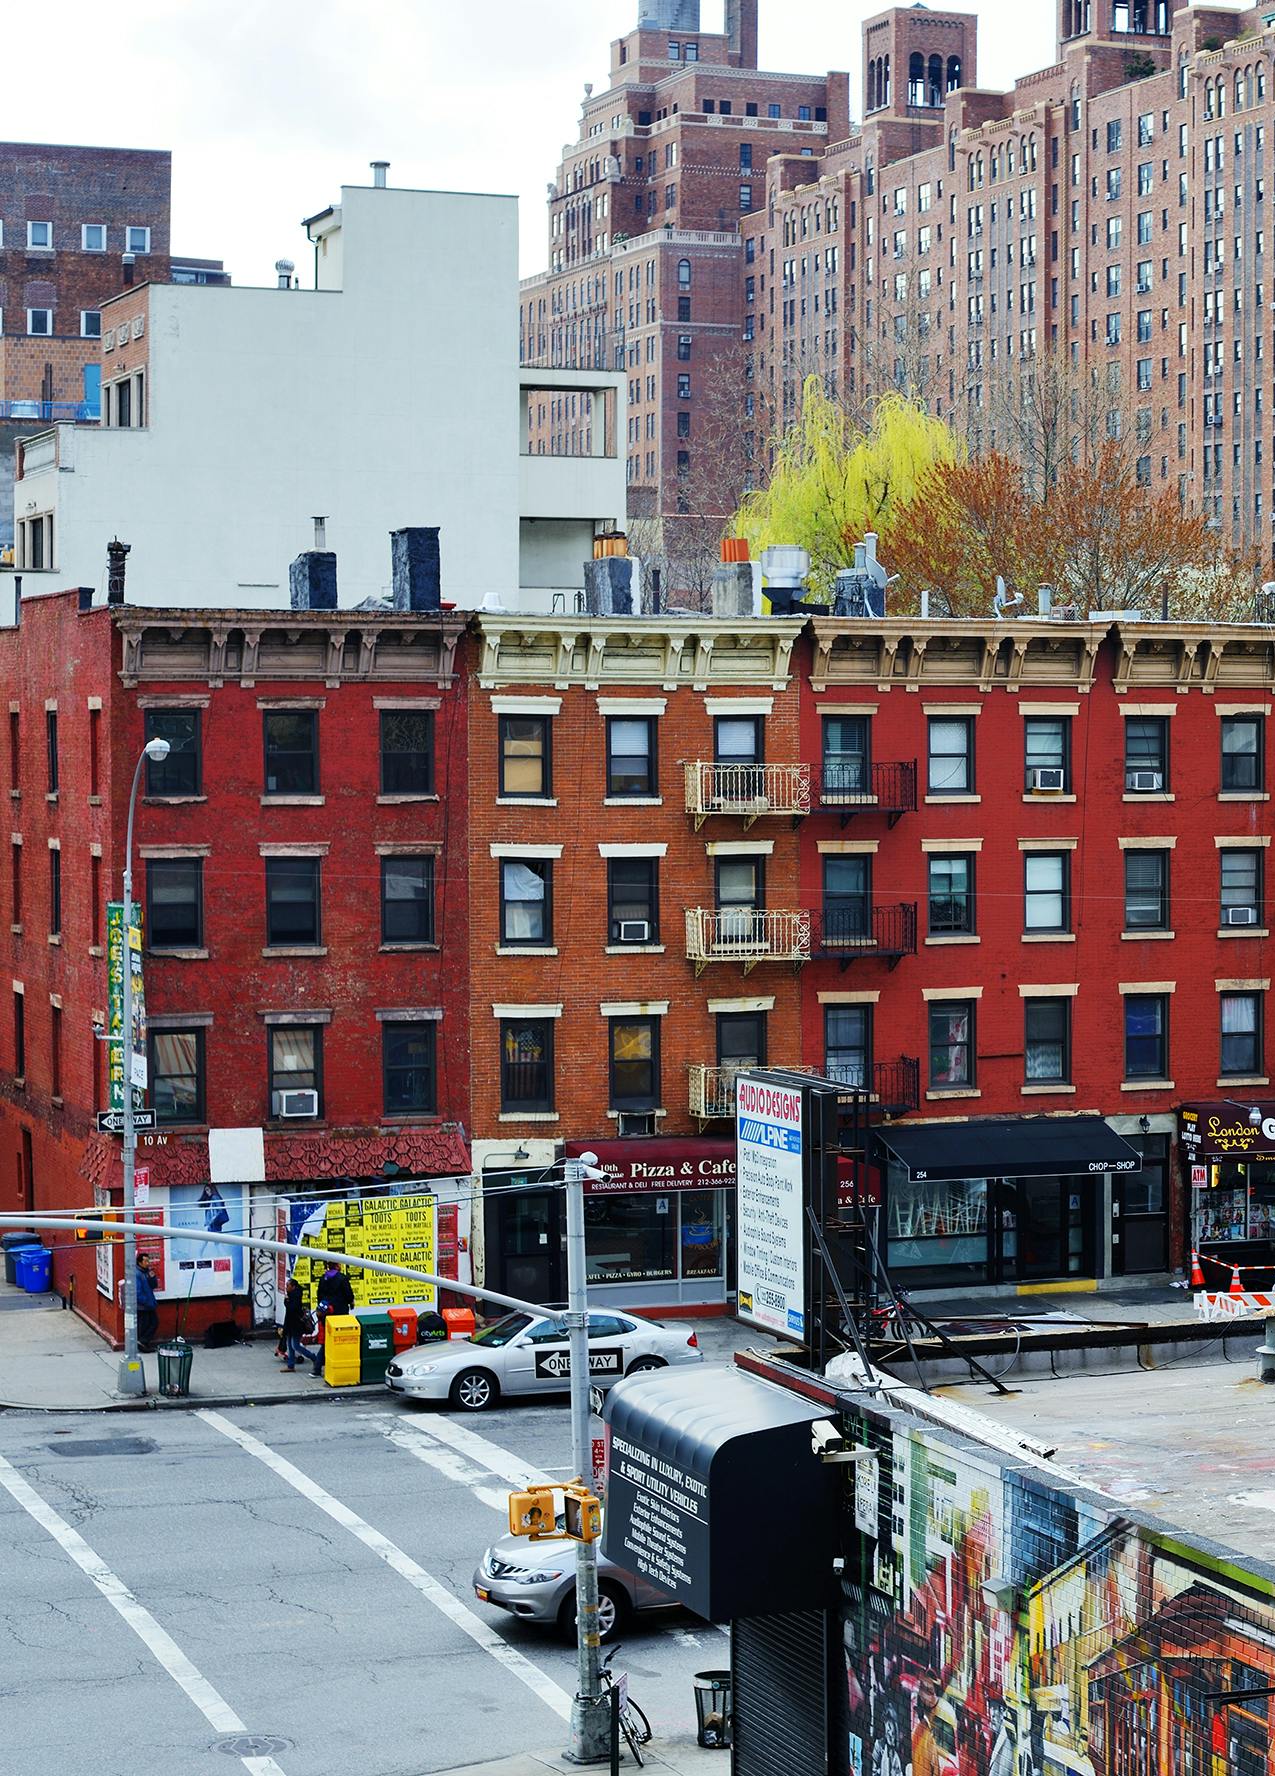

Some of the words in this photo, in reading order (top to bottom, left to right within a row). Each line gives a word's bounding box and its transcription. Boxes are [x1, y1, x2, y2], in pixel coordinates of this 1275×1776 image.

[107, 1117, 124, 1126] ONE
[1207, 1116, 1260, 1137] London
[144, 1136, 153, 1145] 10
[741, 1120, 788, 1149] ALPINE
[600, 1164, 618, 1172] 10th
[630, 1162, 675, 1178] Pizza
[680, 1161, 693, 1175] &
[698, 1159, 736, 1175] Cafe
[916, 1171, 927, 1179] 254
[1193, 1168, 1206, 1182] ATM
[591, 1182, 627, 1190] RESTAURANT
[634, 1181, 648, 1189] DELI
[651, 1180, 665, 1188] FREE
[666, 1179, 693, 1187] DELIVERY
[697, 1177, 736, 1186] 212-366-922
[840, 1180, 854, 1188] 256
[365, 1199, 398, 1211] GALACTIC
[400, 1197, 432, 1209] GALACTIC
[371, 1212, 392, 1223] TOOTS
[406, 1211, 427, 1221] TOOTS
[400, 1251, 432, 1262] GALACTIC
[606, 1271, 623, 1279] PIZZA
[646, 1269, 672, 1277] BURGERS
[421, 1330, 445, 1338] cityArts
[549, 1358, 571, 1370] ONE
[612, 1436, 650, 1467] SPECIALIZING
[651, 1456, 658, 1472] IN
[659, 1460, 684, 1488] LUXURY,
[685, 1475, 708, 1498] EXOTIC
[620, 1461, 626, 1475] &
[626, 1464, 646, 1485] SPORT
[646, 1474, 669, 1497] UTILITY
[670, 1487, 698, 1515] VEHICLES
[636, 1490, 650, 1506] Exotic
[650, 1498, 660, 1512] Skin
[660, 1504, 680, 1524] Interiors
[633, 1502, 651, 1520] Exterior
[650, 1512, 683, 1539] Enhancements
[629, 1513, 652, 1534] Audiophile
[652, 1526, 667, 1543] Sound
[667, 1534, 687, 1555] Systems
[631, 1527, 647, 1545] Mobile
[647, 1536, 663, 1554] Theater
[664, 1546, 684, 1567] Systems
[624, 1536, 651, 1561] Convenience
[651, 1552, 655, 1563] &
[655, 1554, 671, 1575] Safety
[671, 1564, 692, 1585] Systems
[637, 1557, 648, 1573] High
[648, 1563, 659, 1579] Tech
[659, 1570, 677, 1590] Devices
